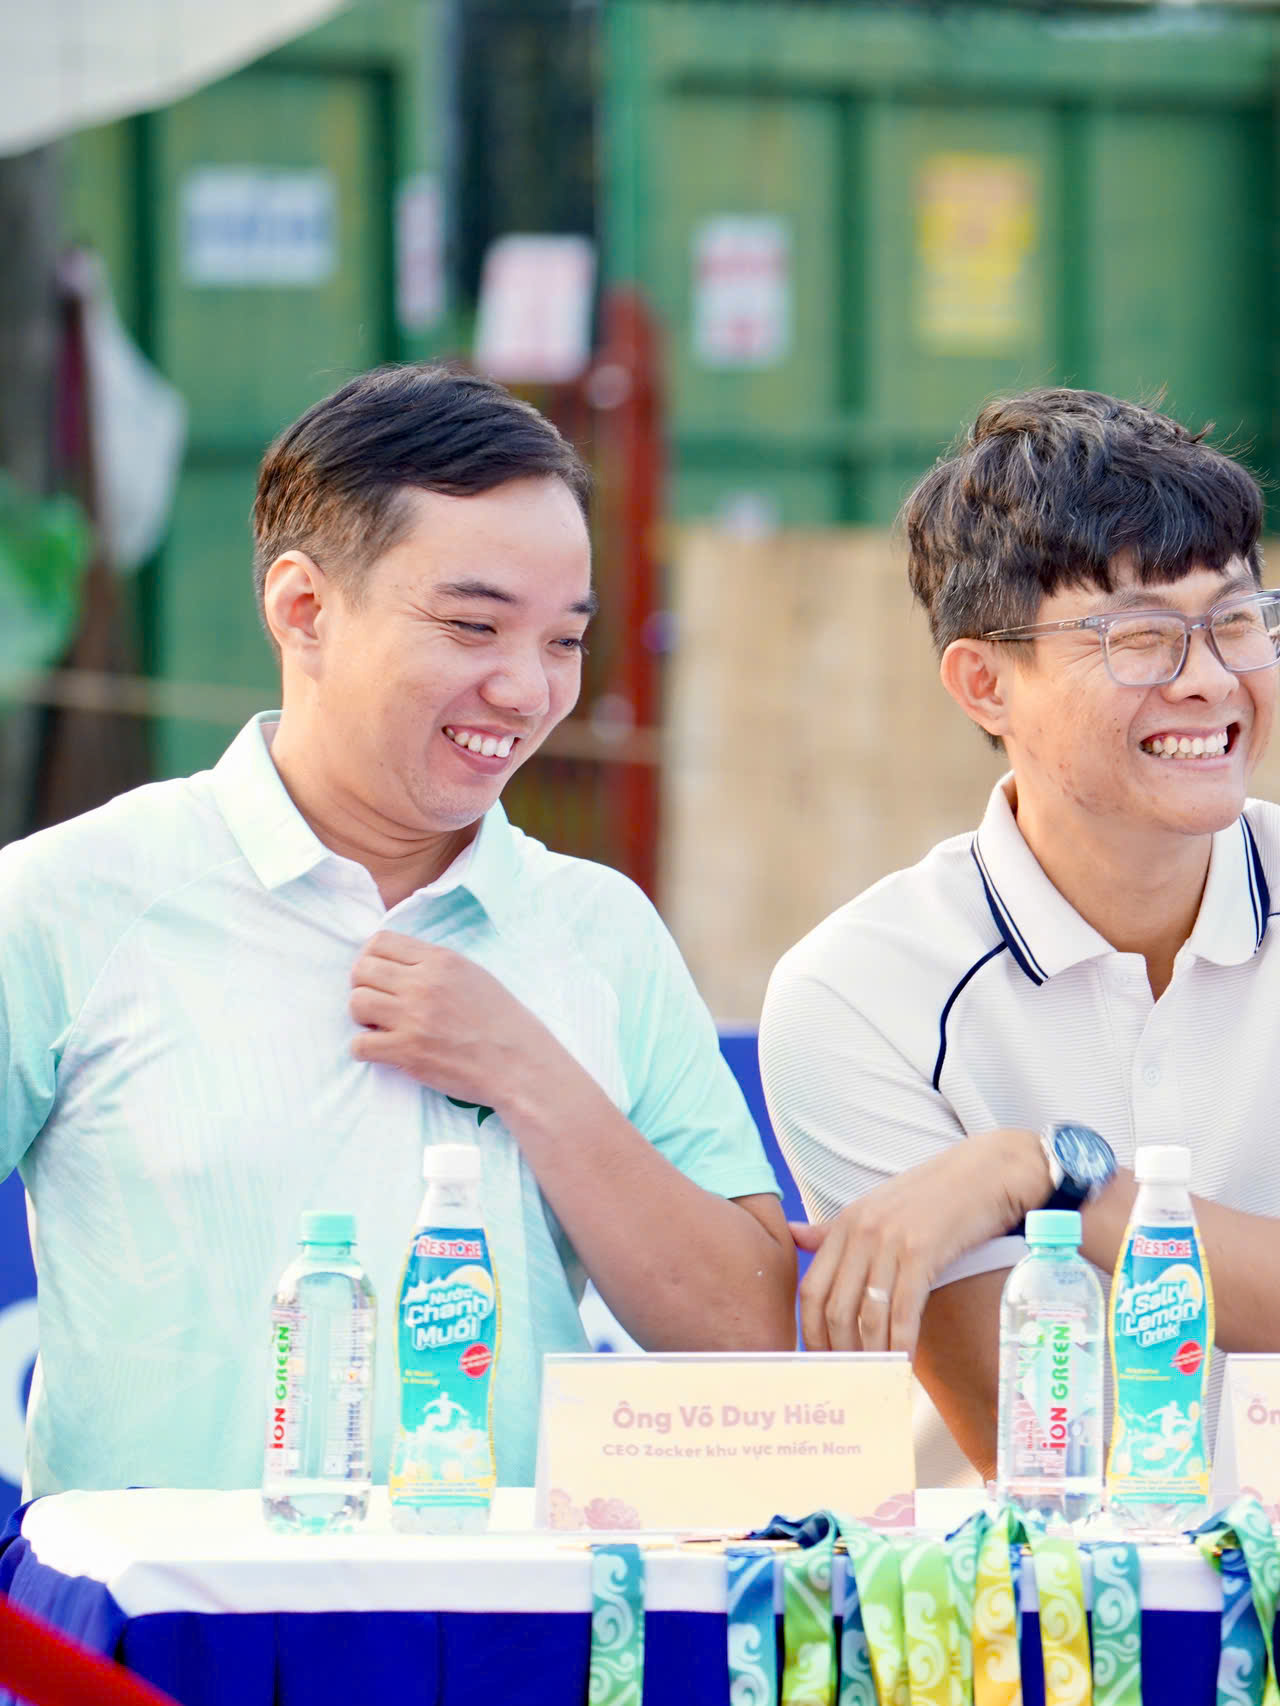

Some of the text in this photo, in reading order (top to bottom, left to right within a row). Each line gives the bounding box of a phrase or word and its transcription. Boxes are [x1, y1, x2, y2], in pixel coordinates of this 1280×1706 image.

[1133, 1238, 1191, 1257] RESTORE
[408, 1295, 489, 1326] Chanh
[1135, 1282, 1188, 1314] Salty
[1126, 1300, 1200, 1333] Lemon
[1141, 1326, 1179, 1346] Drink
[275, 1326, 290, 1400] GREEN
[1051, 1326, 1071, 1400] GREEN
[612, 1400, 672, 1434] Ông
[721, 1405, 776, 1430] Duy
[602, 1444, 640, 1457] CEO
[644, 1444, 701, 1458] Zocker
[706, 1445, 738, 1457] khu
[743, 1445, 772, 1459] vực
[823, 1442, 862, 1455] Nam
